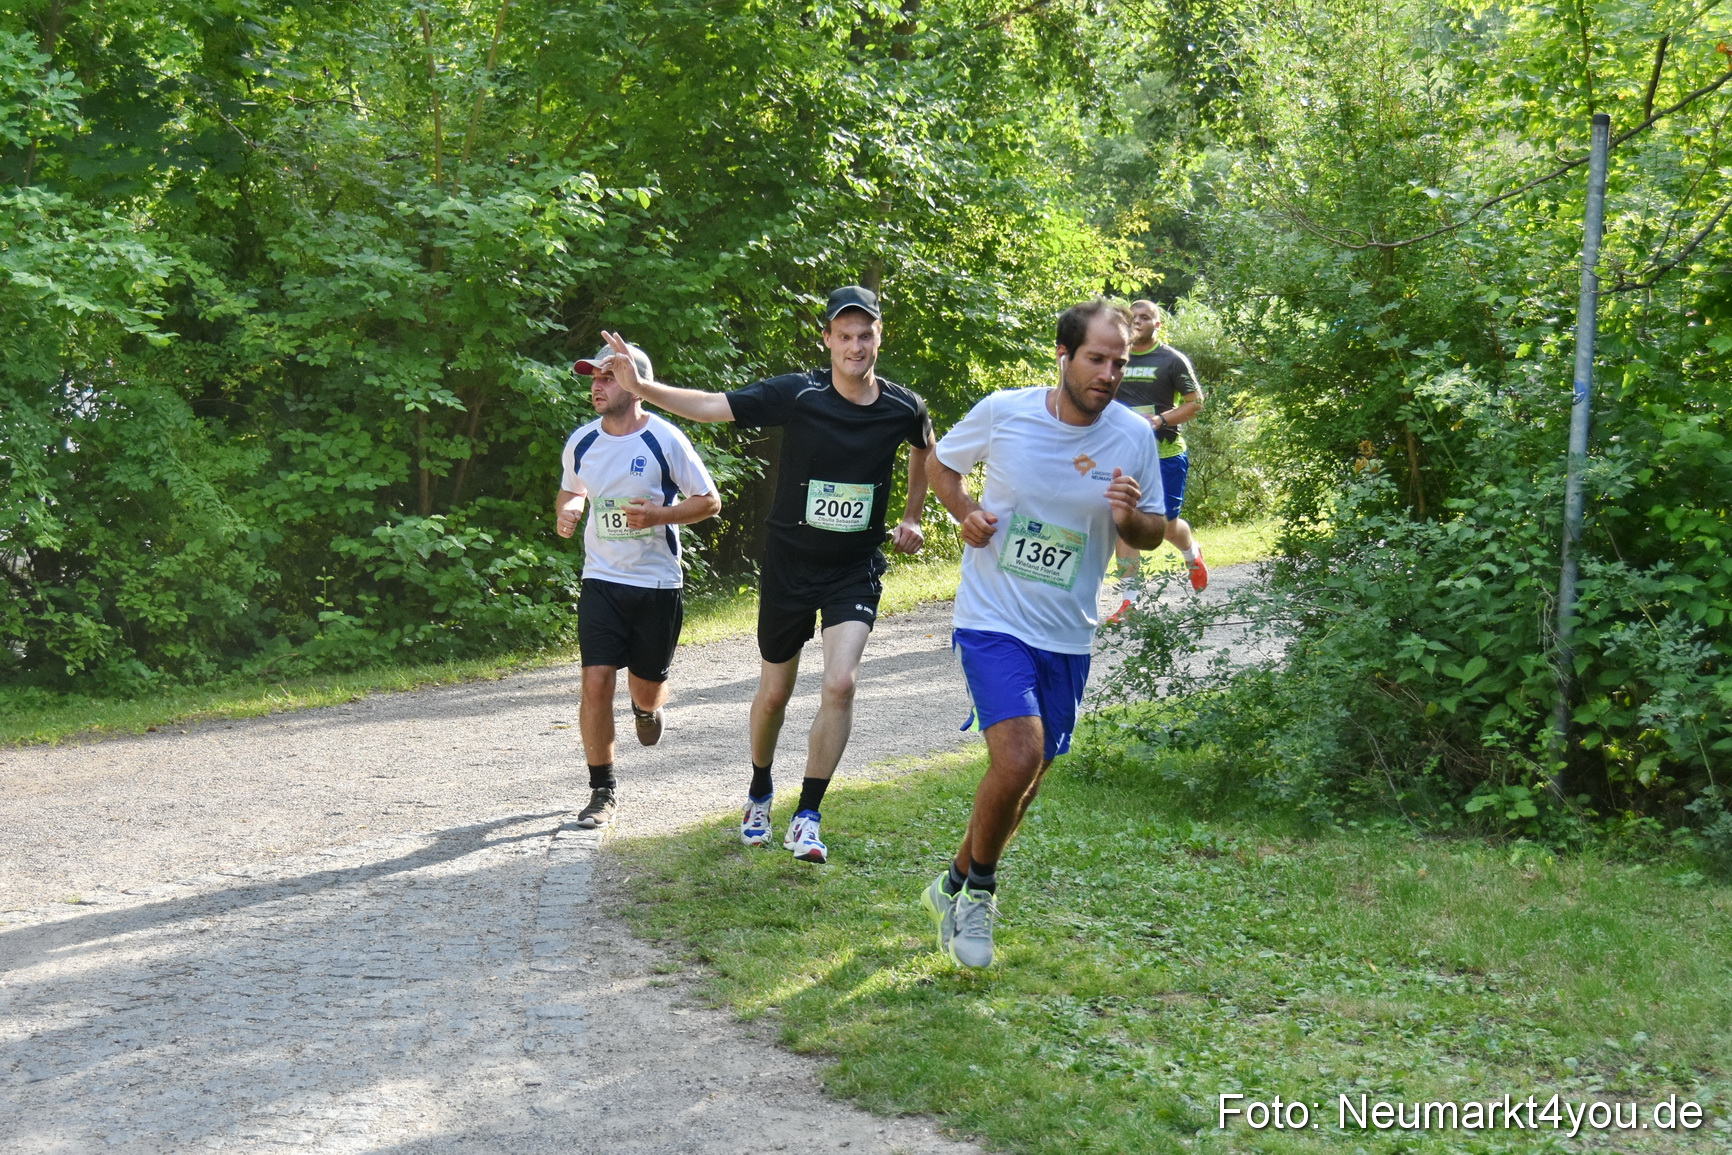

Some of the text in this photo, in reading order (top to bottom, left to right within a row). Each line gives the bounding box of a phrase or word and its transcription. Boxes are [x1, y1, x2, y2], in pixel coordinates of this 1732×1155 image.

[1124, 367, 1158, 379] OCK
[814, 499, 864, 519] 2002
[1015, 538, 1072, 570] 1367
[1015, 559, 1060, 577] Wieland Florian
